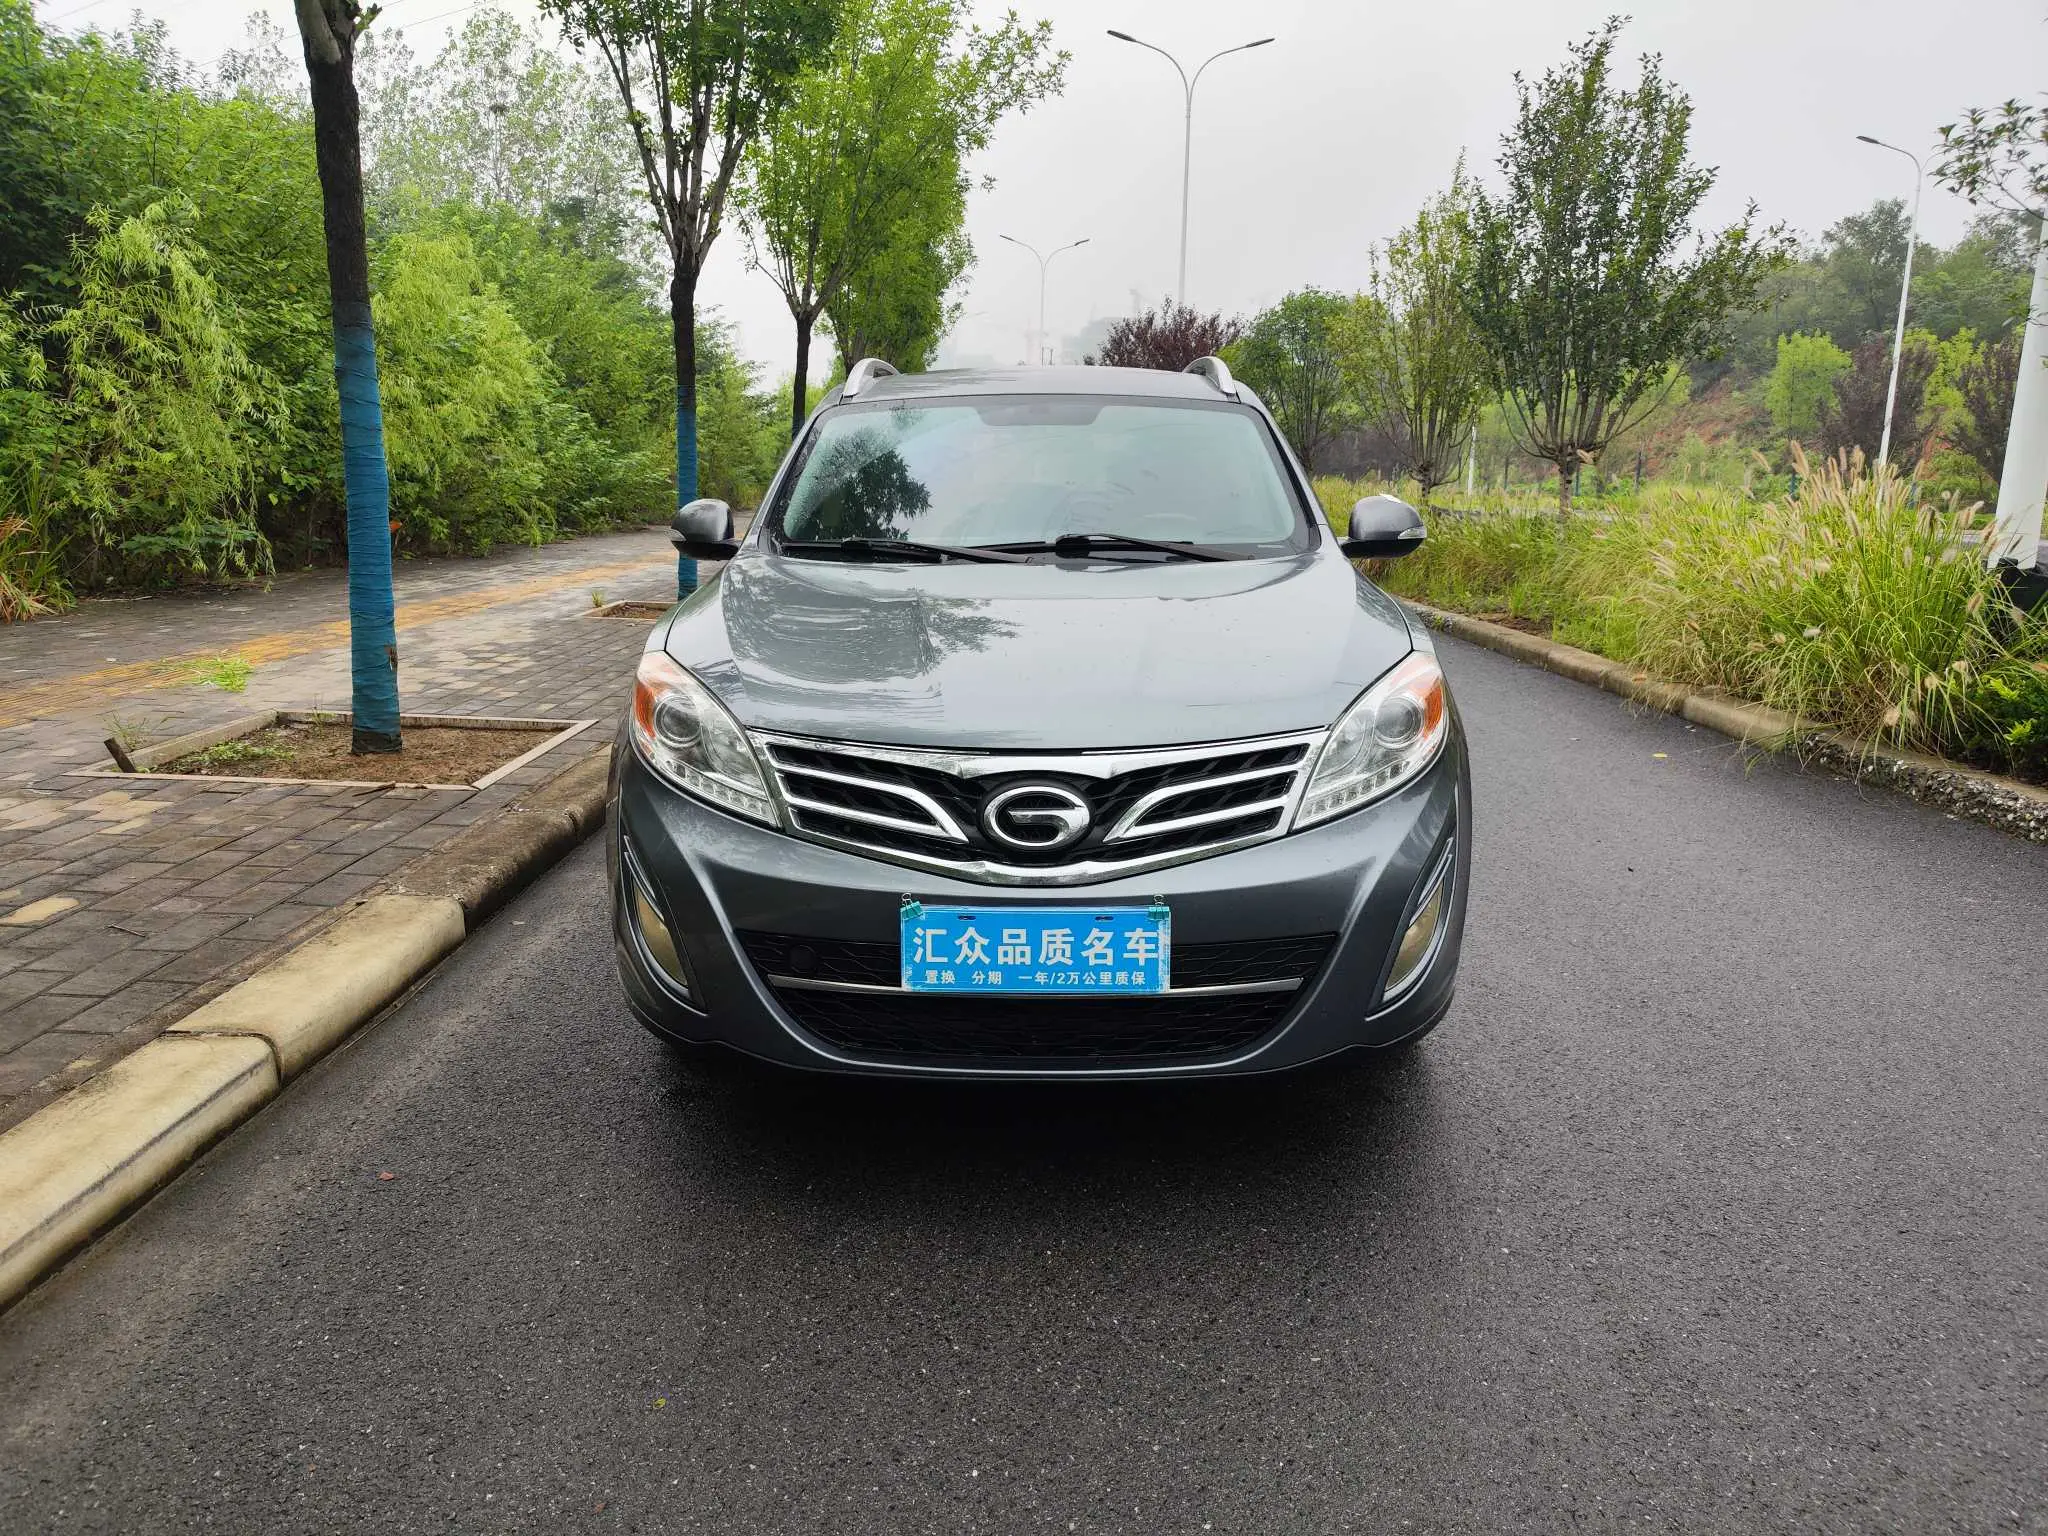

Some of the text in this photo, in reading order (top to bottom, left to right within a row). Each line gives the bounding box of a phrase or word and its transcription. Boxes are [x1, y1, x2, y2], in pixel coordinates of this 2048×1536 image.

[912, 926, 1160, 967] 汇众品质名车
[925, 970, 1146, 985] 置换 分期 一年/2万公里质保
